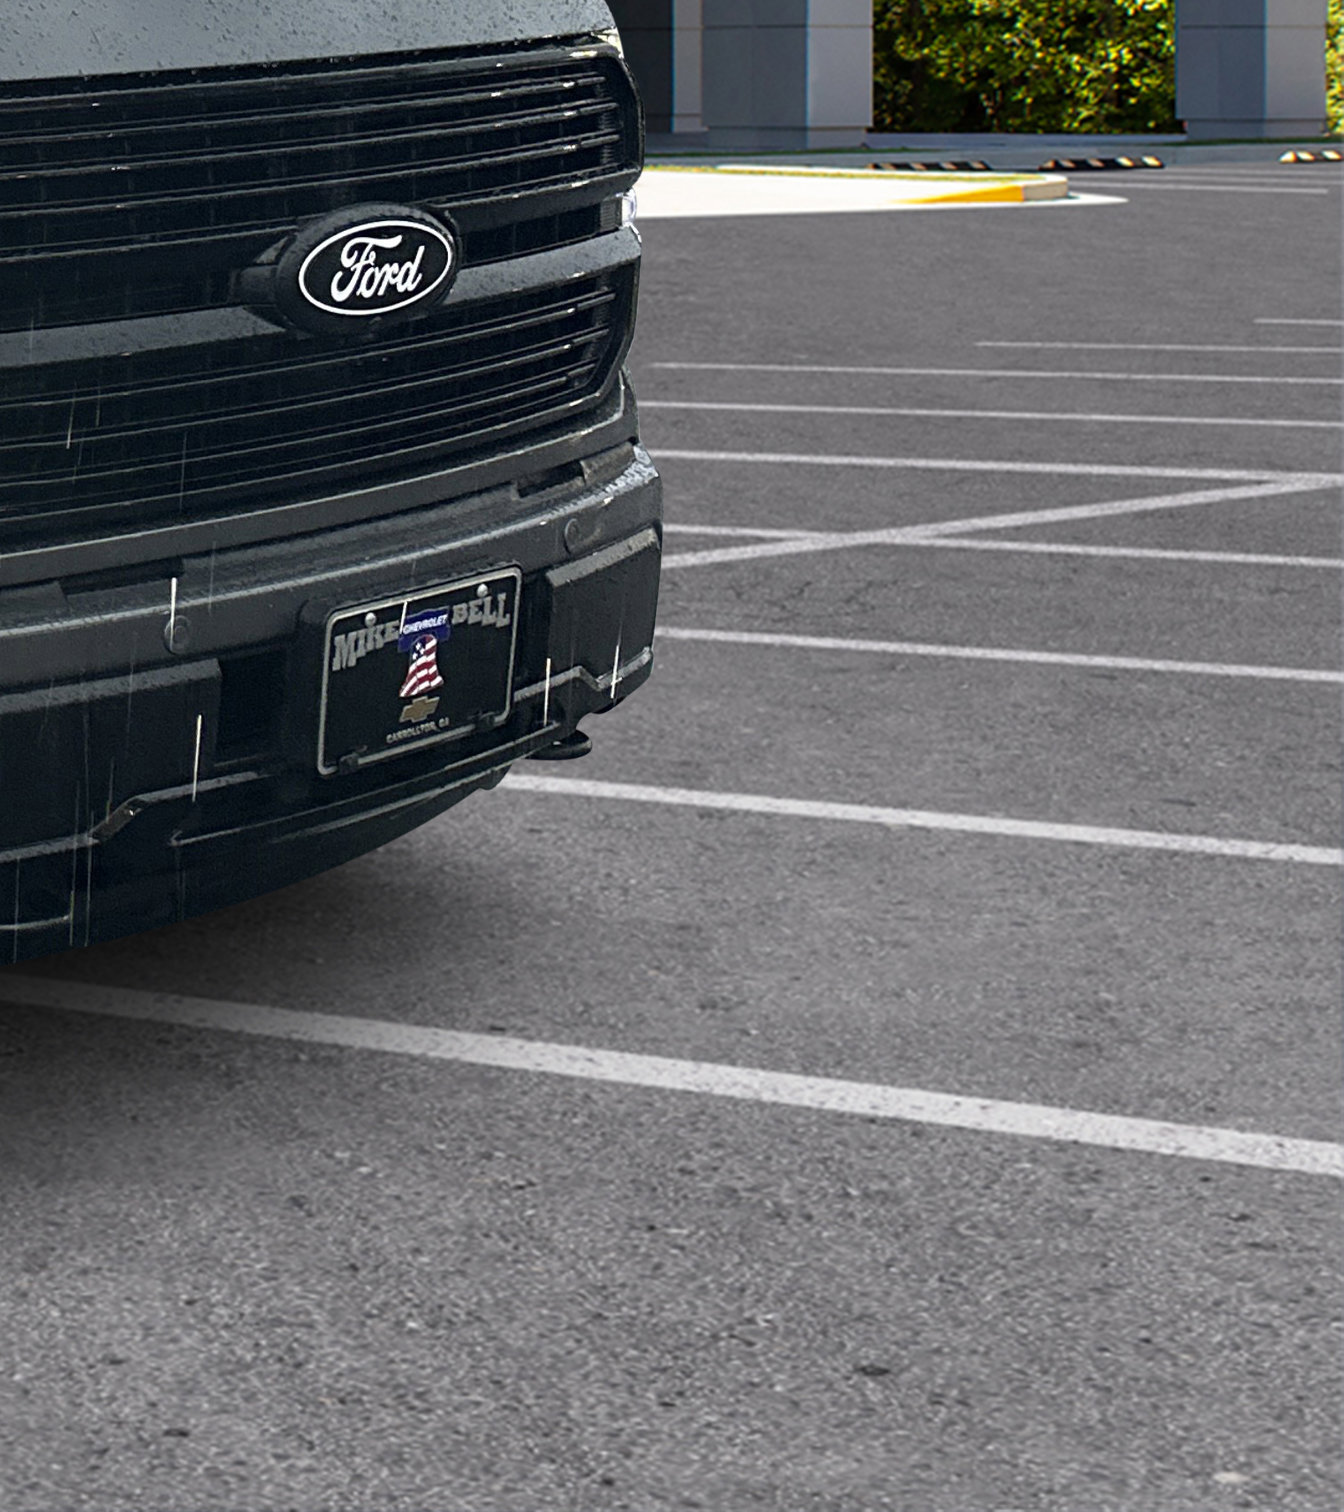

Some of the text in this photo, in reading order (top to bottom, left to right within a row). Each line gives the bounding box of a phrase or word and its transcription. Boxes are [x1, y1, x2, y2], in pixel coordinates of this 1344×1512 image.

[330, 234, 426, 303] Ford
[333, 593, 510, 672] MIKE CHEVROLET BELL
